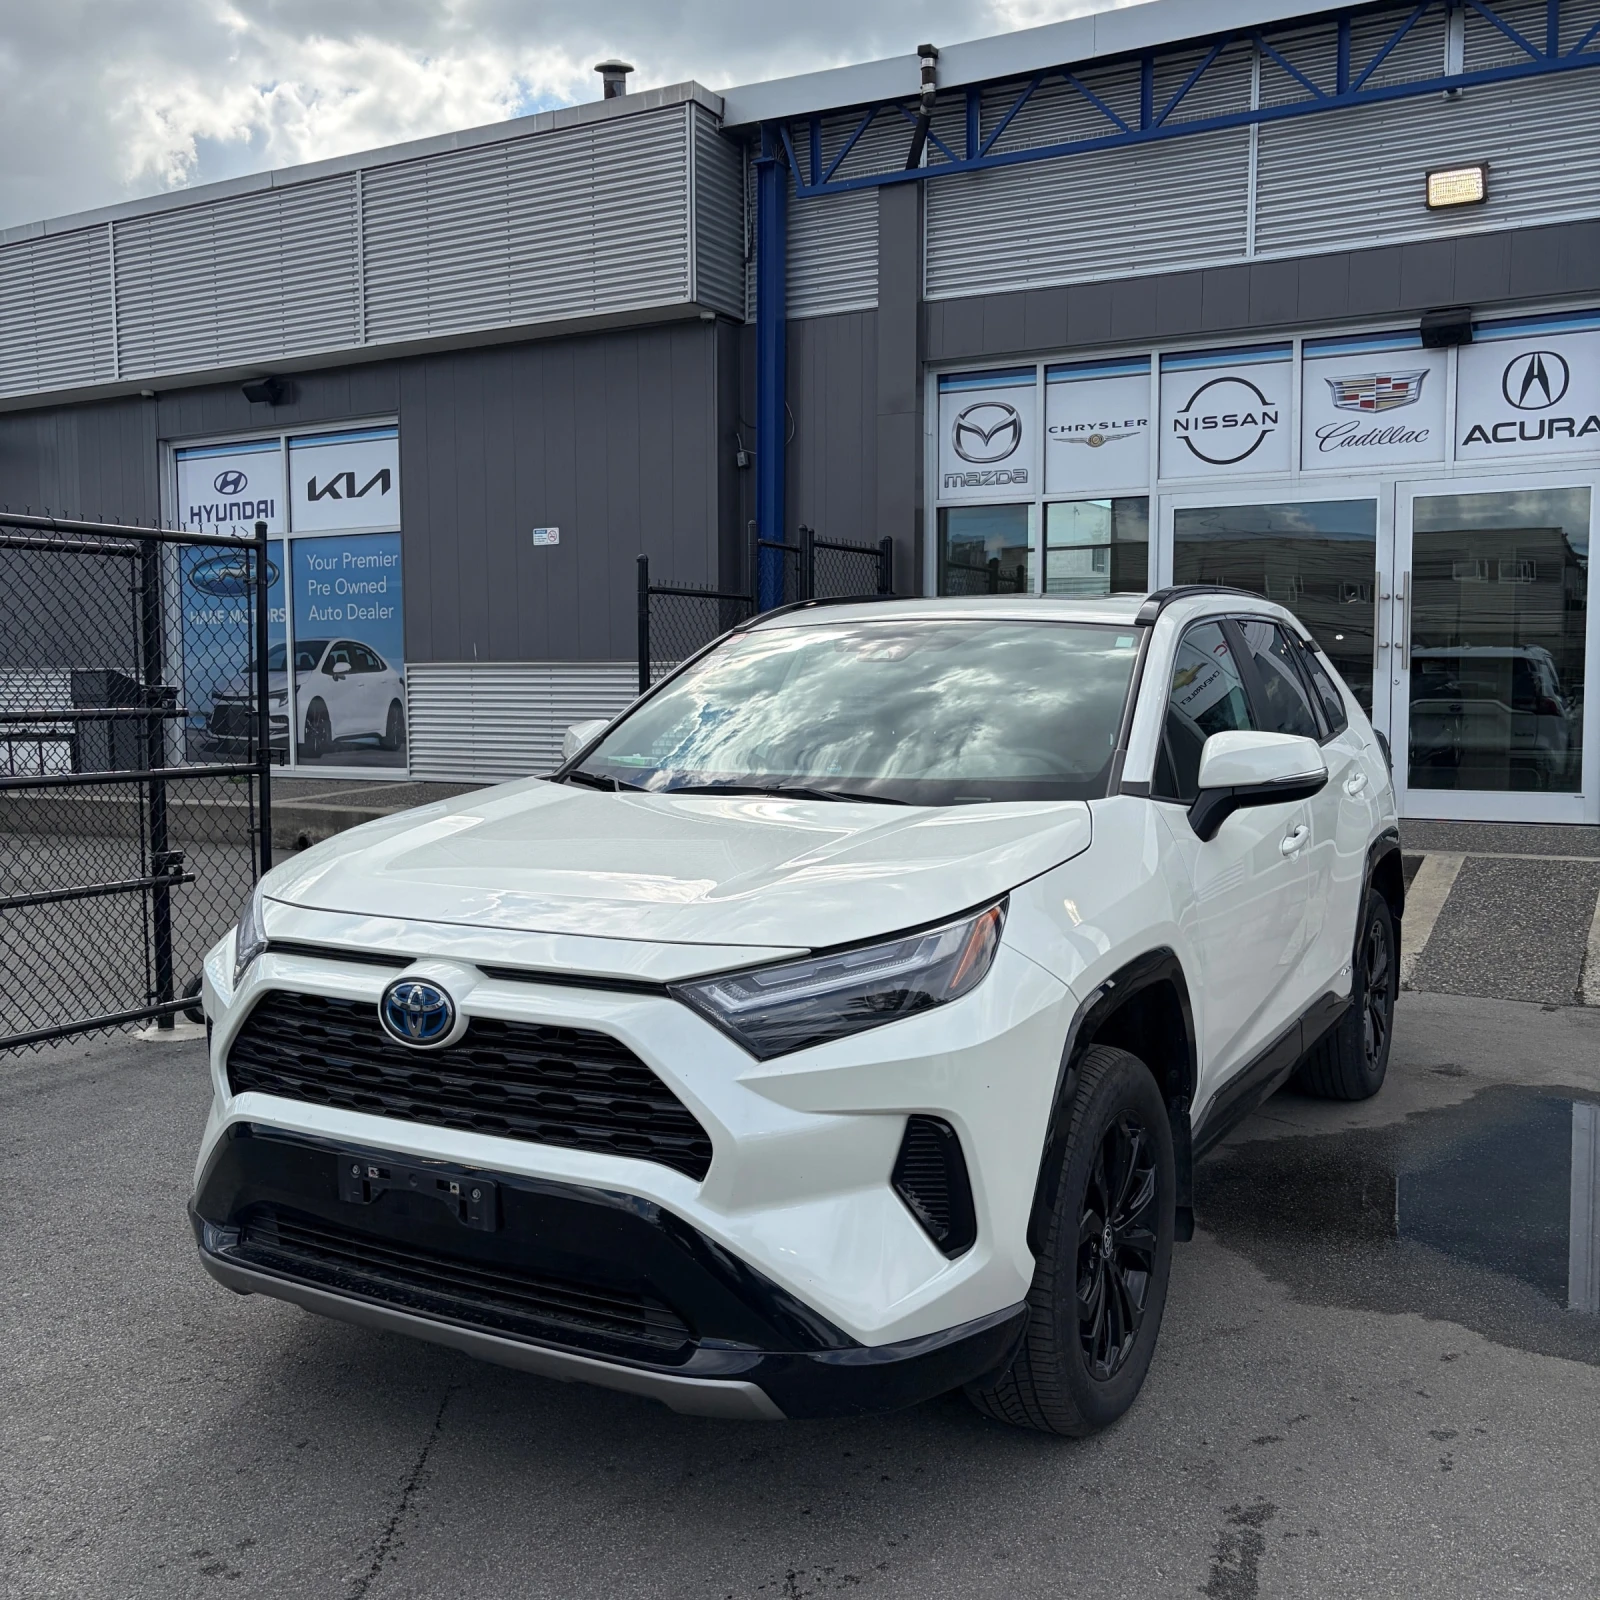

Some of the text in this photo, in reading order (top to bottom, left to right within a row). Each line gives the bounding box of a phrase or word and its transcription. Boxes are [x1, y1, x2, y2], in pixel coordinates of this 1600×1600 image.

[1048, 418, 1148, 434] CHRYSLER
[1173, 409, 1279, 433] NISSAN
[1461, 415, 1600, 446] ACURA
[1315, 420, 1430, 453] Cadillac
[307, 468, 391, 502] KIA
[190, 499, 275, 524] HYUNDAI
[306, 552, 398, 571] Your Premier
[307, 576, 387, 596] Pre Owned
[229, 608, 286, 624] MOTRS
[308, 603, 394, 621] Auto Dealer
